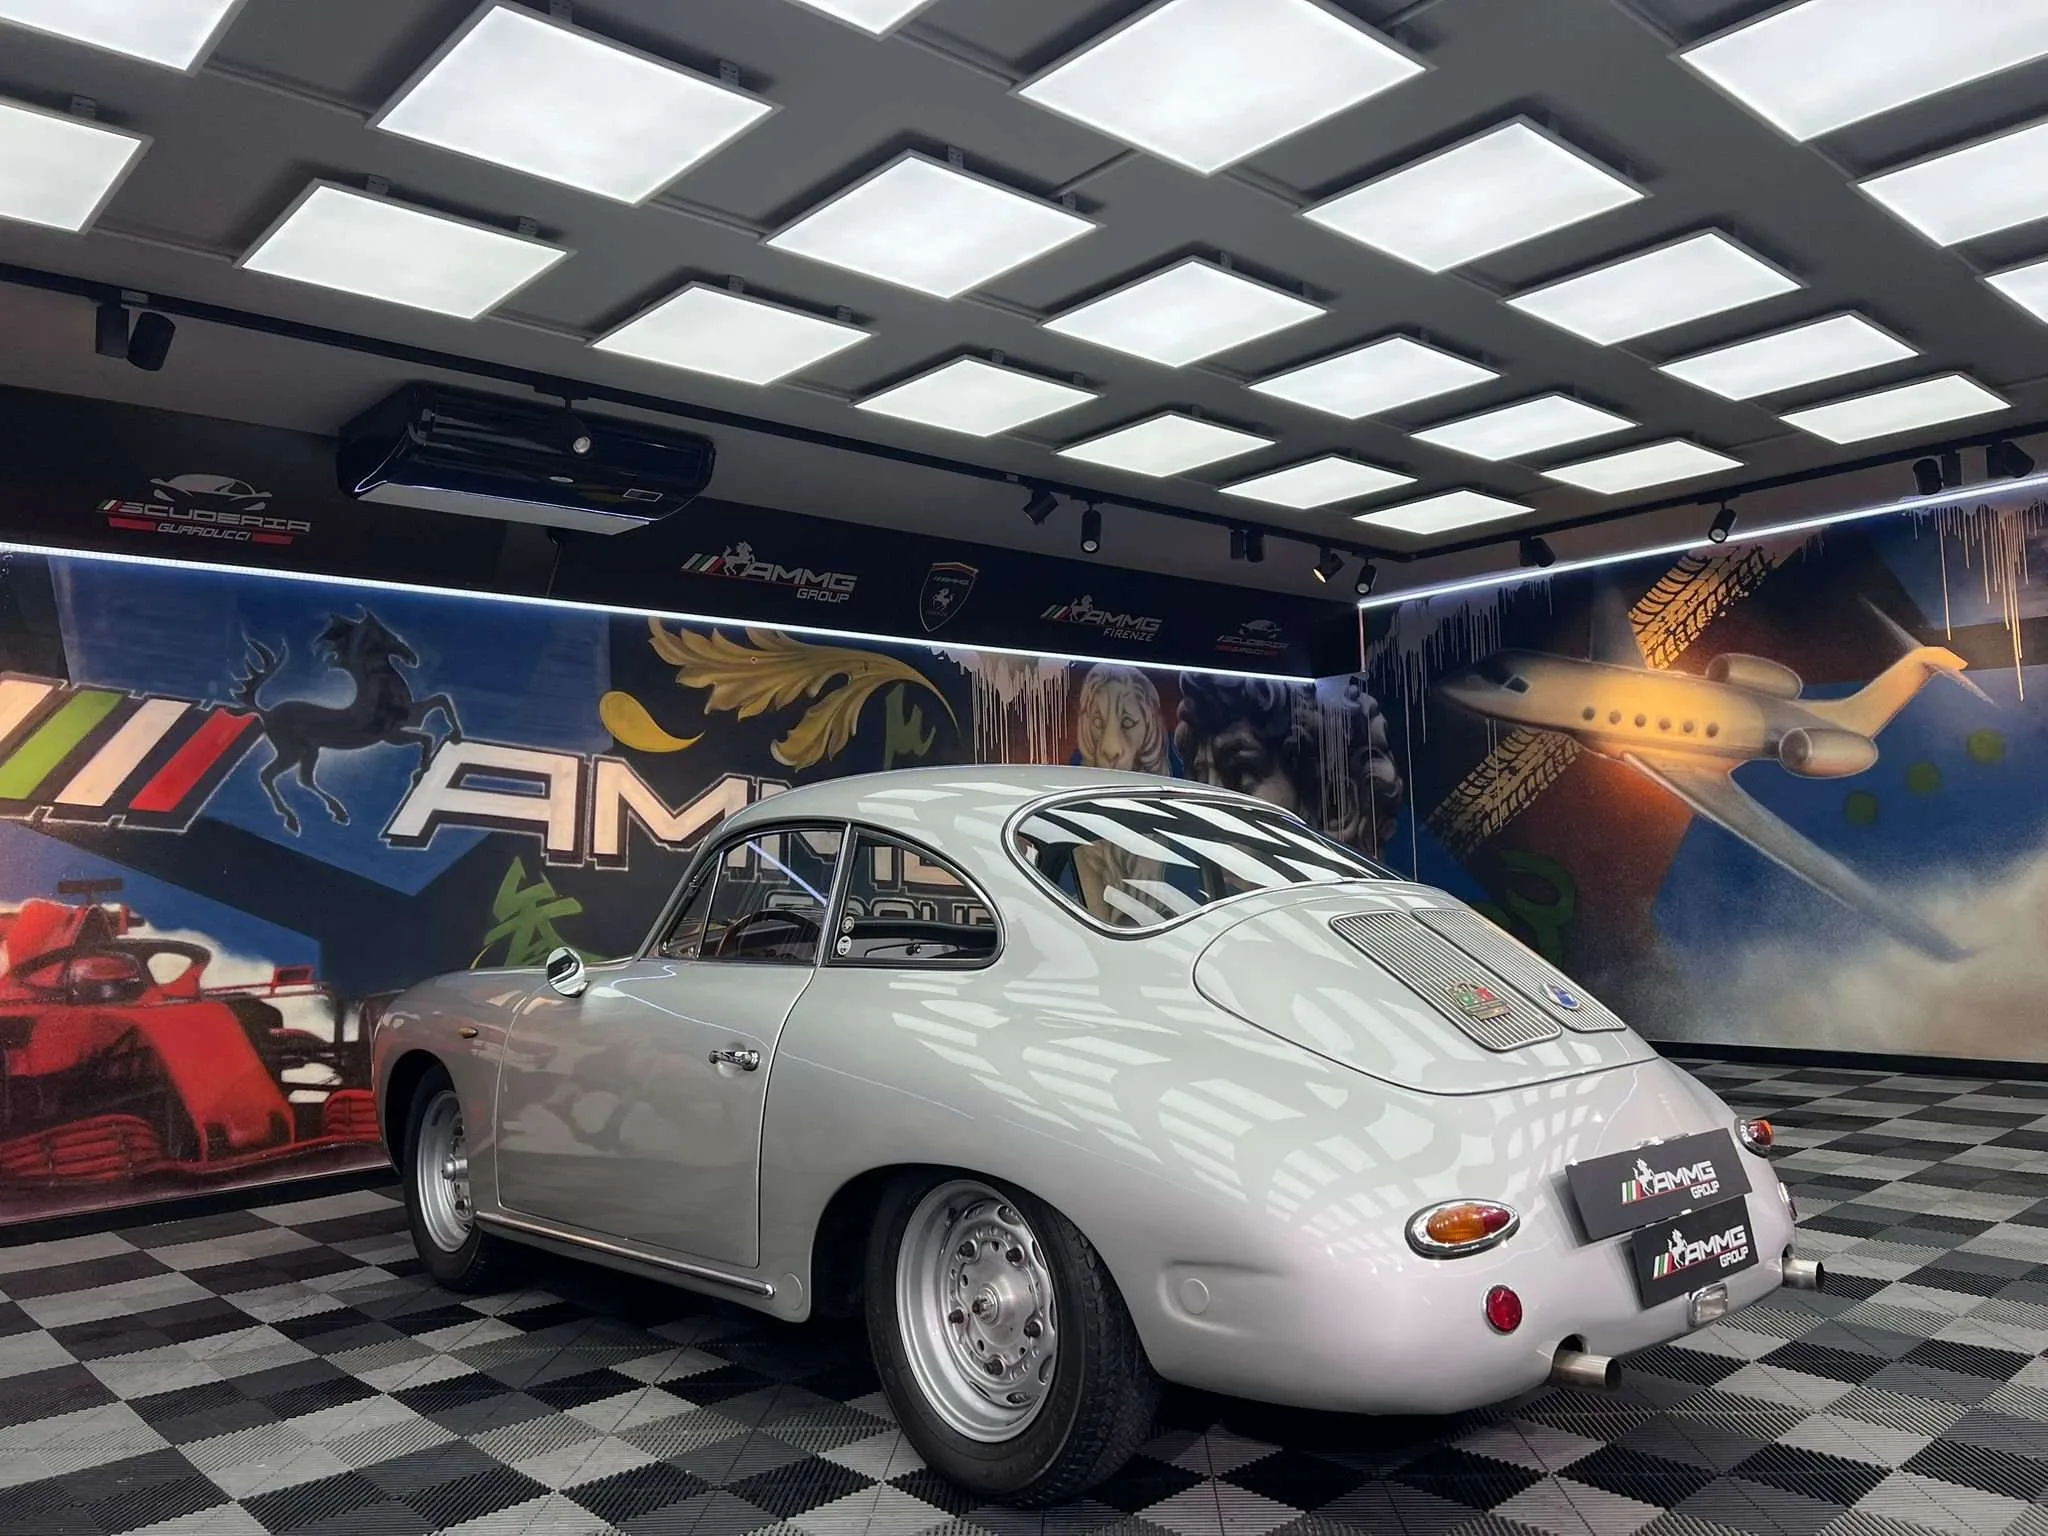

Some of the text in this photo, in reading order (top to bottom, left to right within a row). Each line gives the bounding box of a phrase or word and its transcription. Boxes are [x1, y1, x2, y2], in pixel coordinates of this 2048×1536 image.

[118, 501, 312, 533] SCUDERIA
[742, 562, 858, 591] AMMG
[796, 587, 850, 603] GROUP
[1080, 610, 1163, 632] AMMG
[1103, 627, 1155, 642] FIRENZE
[1653, 1160, 1718, 1194] AMMG
[1690, 1180, 1720, 1199] GROUP
[1684, 1224, 1747, 1267] AMMG
[1719, 1246, 1749, 1268] GROUP
